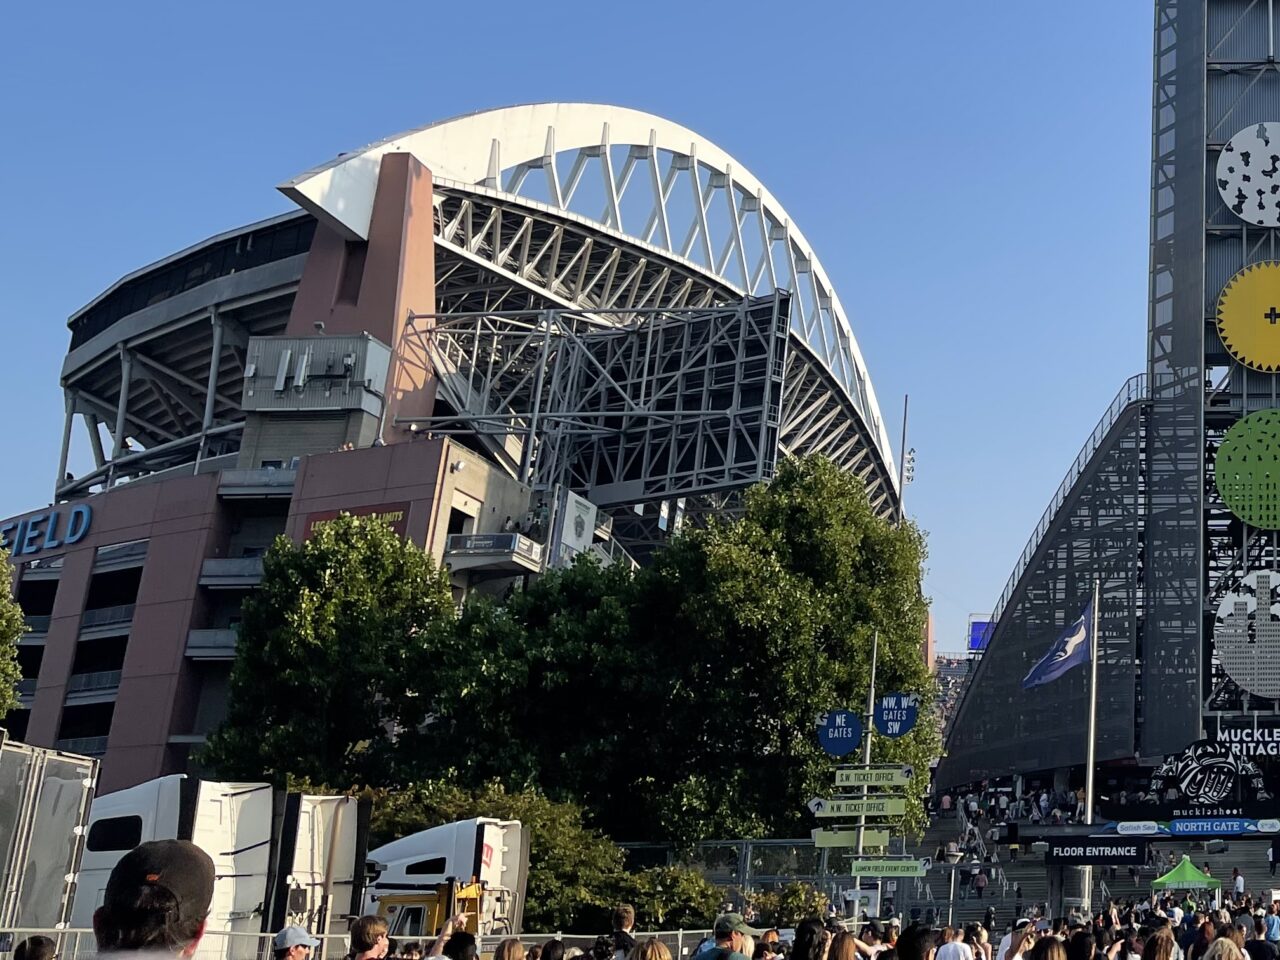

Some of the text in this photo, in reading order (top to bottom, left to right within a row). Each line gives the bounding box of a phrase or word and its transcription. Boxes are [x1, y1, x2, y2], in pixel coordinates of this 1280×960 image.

[883, 710, 907, 720] GATES
[836, 714, 846, 727] NE
[887, 722, 900, 734] SW
[828, 728, 852, 739] GATES
[854, 773, 873, 782] TICKET
[875, 772, 894, 782] OFFICE
[845, 803, 864, 813] TICKET
[866, 803, 885, 812] OFFICE
[1175, 821, 1240, 832] NORTH GATE
[1053, 847, 1137, 856] FLOOR ENTRANCE
